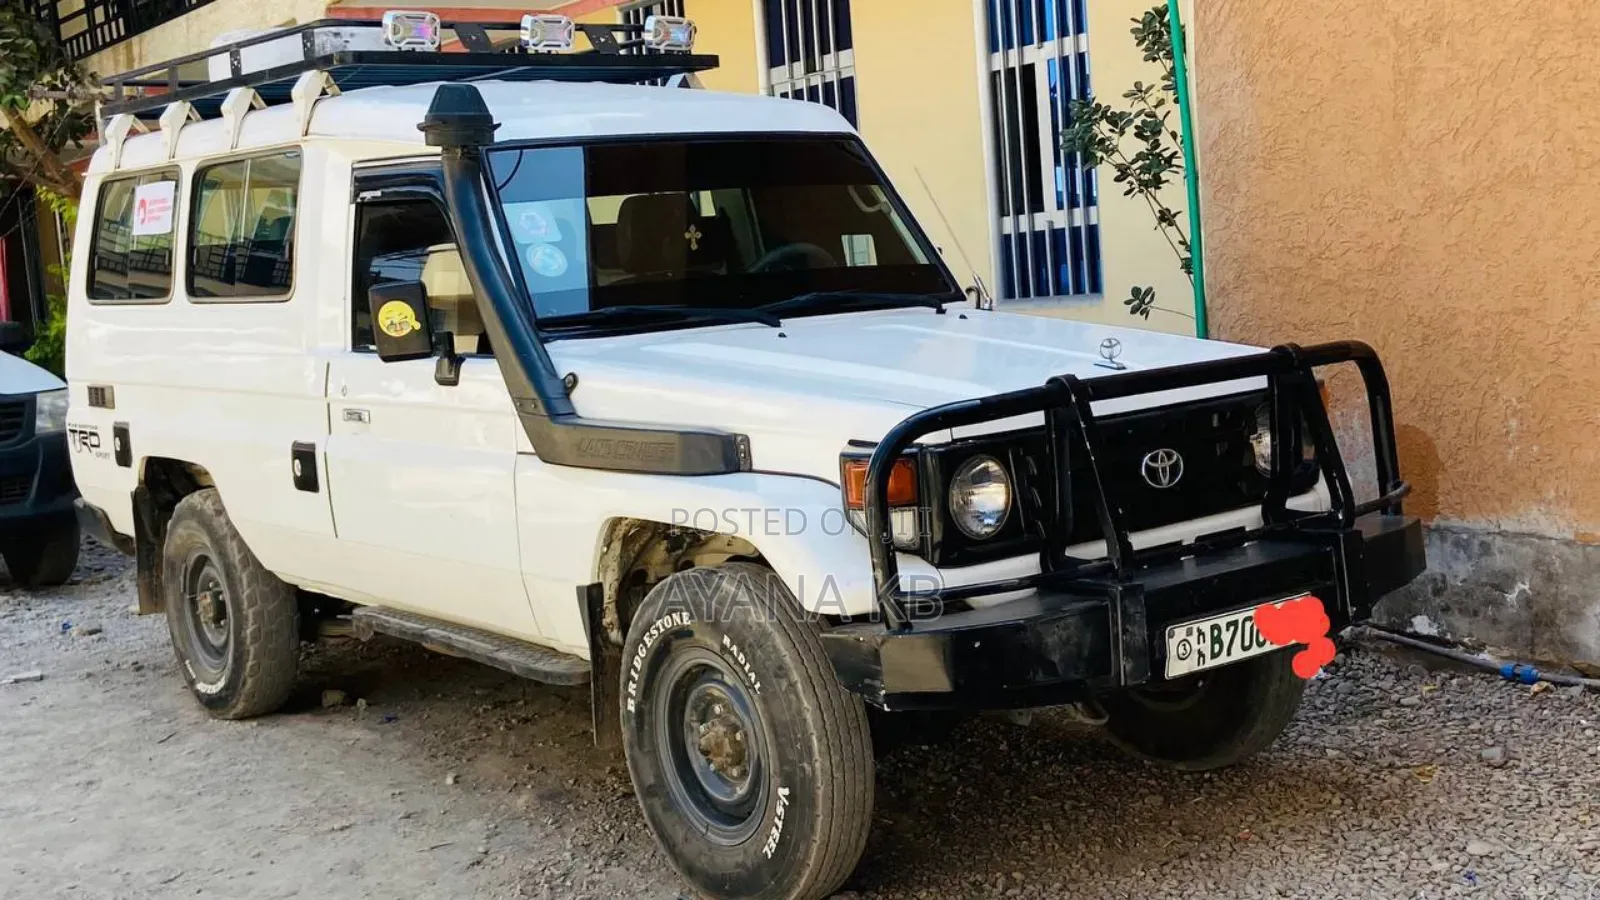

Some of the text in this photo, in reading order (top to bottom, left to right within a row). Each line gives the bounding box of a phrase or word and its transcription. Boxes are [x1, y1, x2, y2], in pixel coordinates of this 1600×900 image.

[68, 429, 100, 453] TRD
[626, 611, 692, 714] BRIDGESTONE
[722, 634, 762, 695] RADIAL
